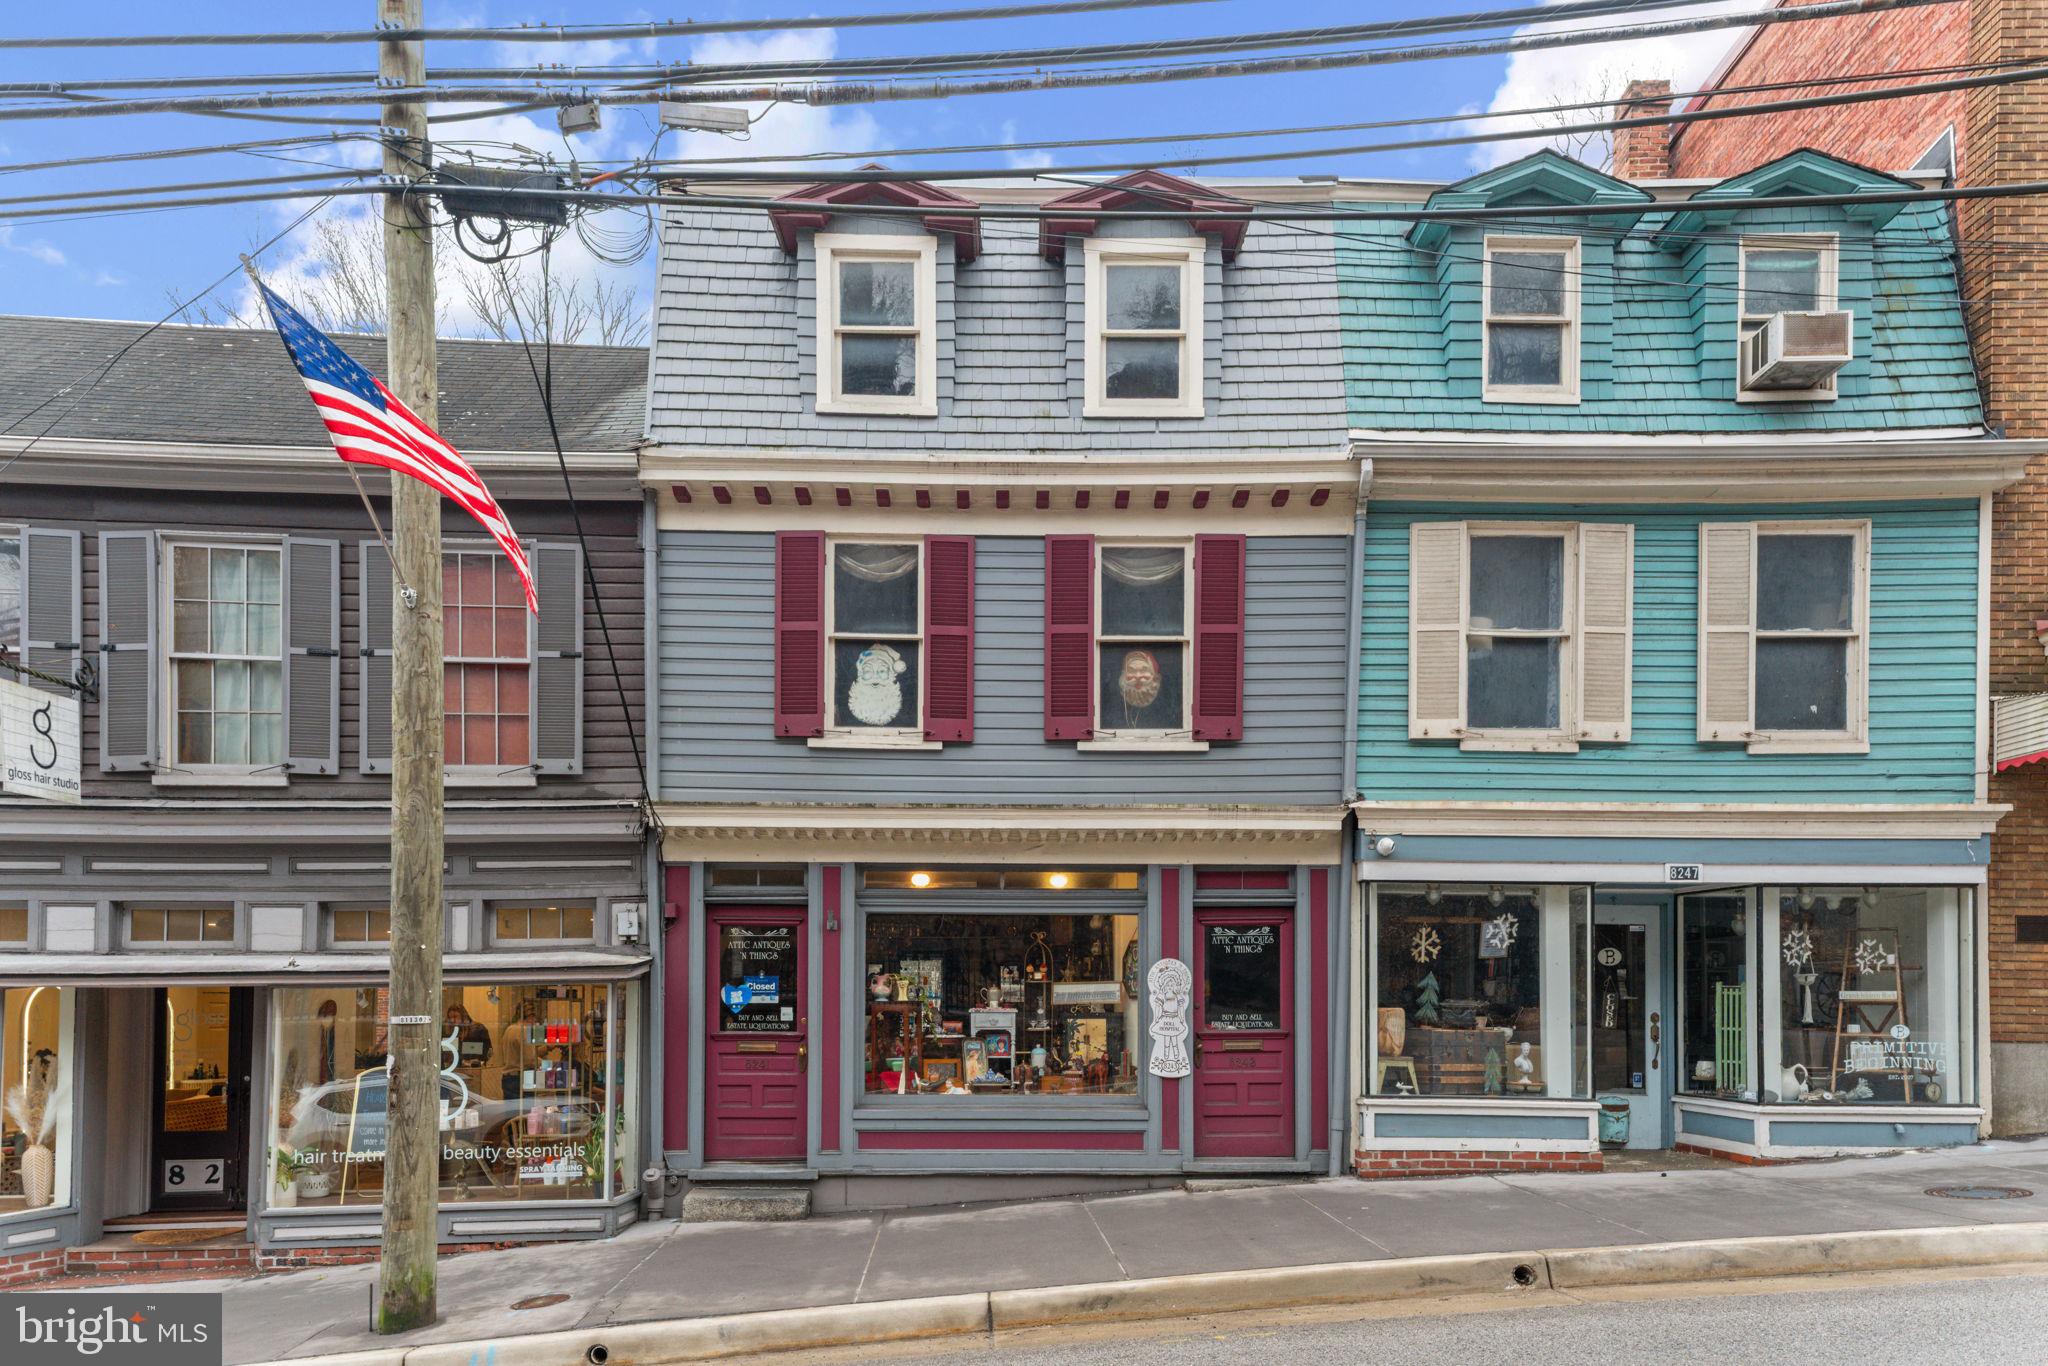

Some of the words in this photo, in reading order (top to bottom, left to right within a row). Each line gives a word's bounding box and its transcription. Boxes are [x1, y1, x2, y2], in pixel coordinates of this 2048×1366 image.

[8, 767, 32, 781] gloss
[34, 771, 51, 785] hair
[53, 777, 79, 790] studio
[1671, 867, 1698, 879] 8247
[728, 940, 750, 949] ATTIC
[753, 940, 790, 950] ANTIQUES
[1212, 936, 1234, 944] ATTIC
[1237, 936, 1275, 945] ANTIQUES
[1234, 945, 1263, 953] THINGS
[750, 951, 779, 960] THINGS
[1604, 950, 1616, 963] B
[747, 982, 776, 991] Closed
[1605, 993, 1616, 1027] CLOSED
[726, 1022, 747, 1030] ESTATE
[748, 1022, 790, 1031] LIQUIDATIONS
[1232, 1021, 1274, 1029] LIQUIDATIONS
[1896, 1026, 1905, 1038] B
[1850, 1041, 1951, 1055] PRIMITIVE
[294, 1149, 327, 1164] hair
[332, 1148, 386, 1163] treatm
[443, 1145, 501, 1163] beauty
[506, 1142, 586, 1159] essentials
[544, 1164, 583, 1173] TANNING
[169, 1165, 185, 1185] 8
[205, 1164, 220, 1184] 2
